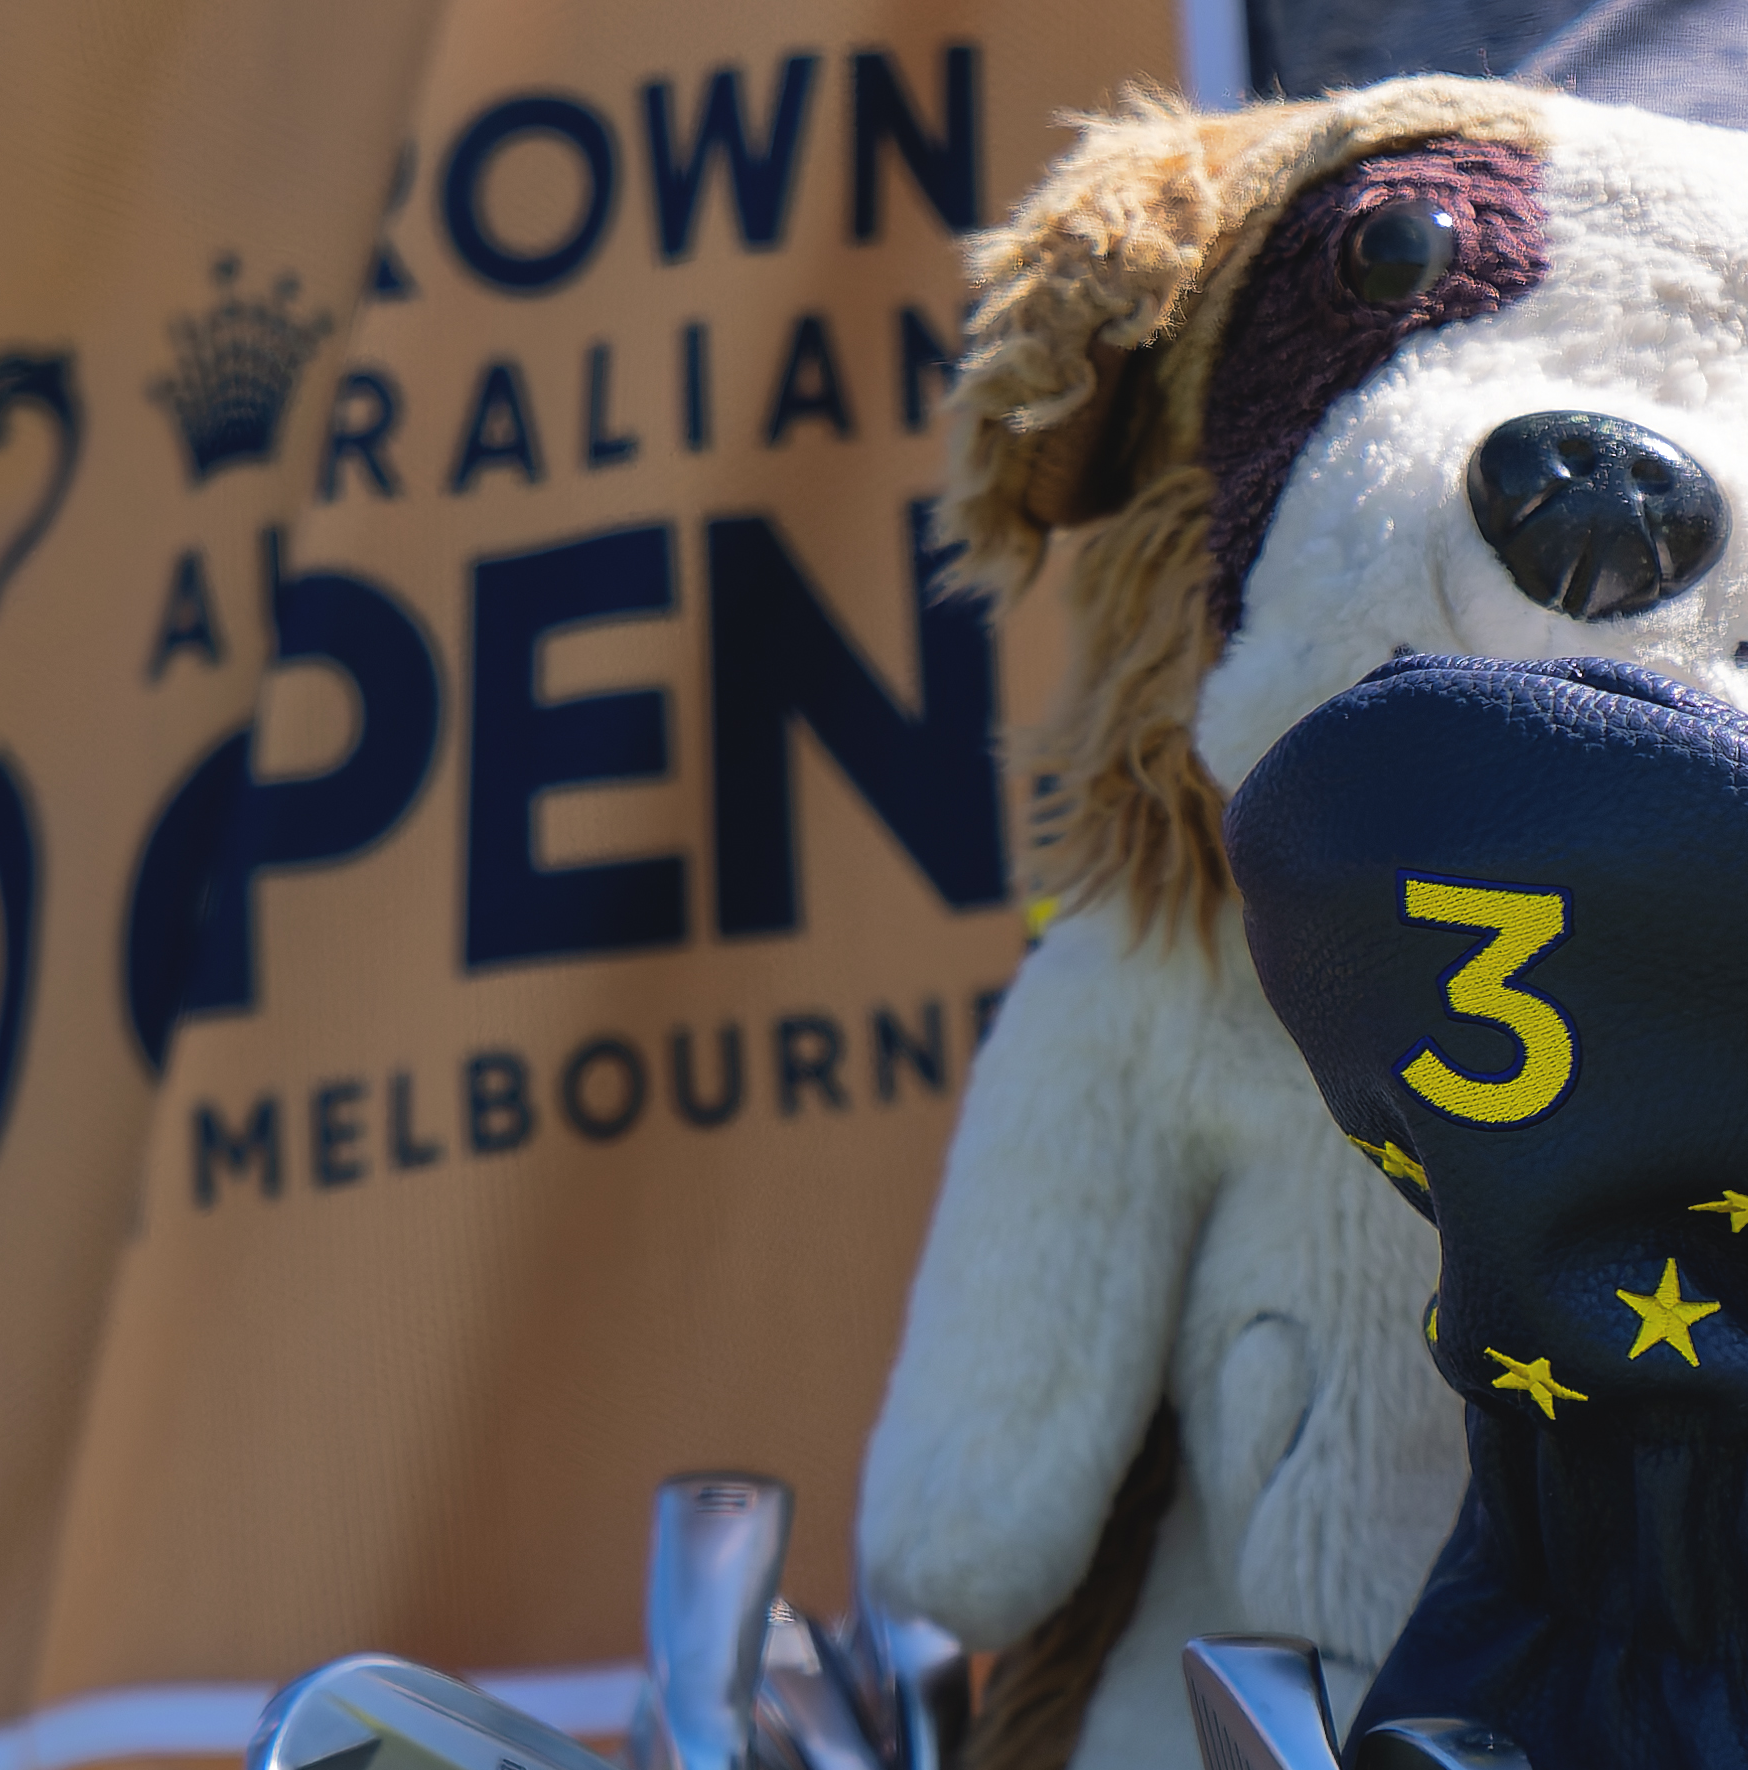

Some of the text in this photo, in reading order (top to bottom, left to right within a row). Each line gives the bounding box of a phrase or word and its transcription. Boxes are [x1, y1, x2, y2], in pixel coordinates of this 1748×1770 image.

[365, 43, 983, 300] OWN
[189, 988, 1005, 1210] MELBOURN
[1393, 868, 1581, 1132] 3
